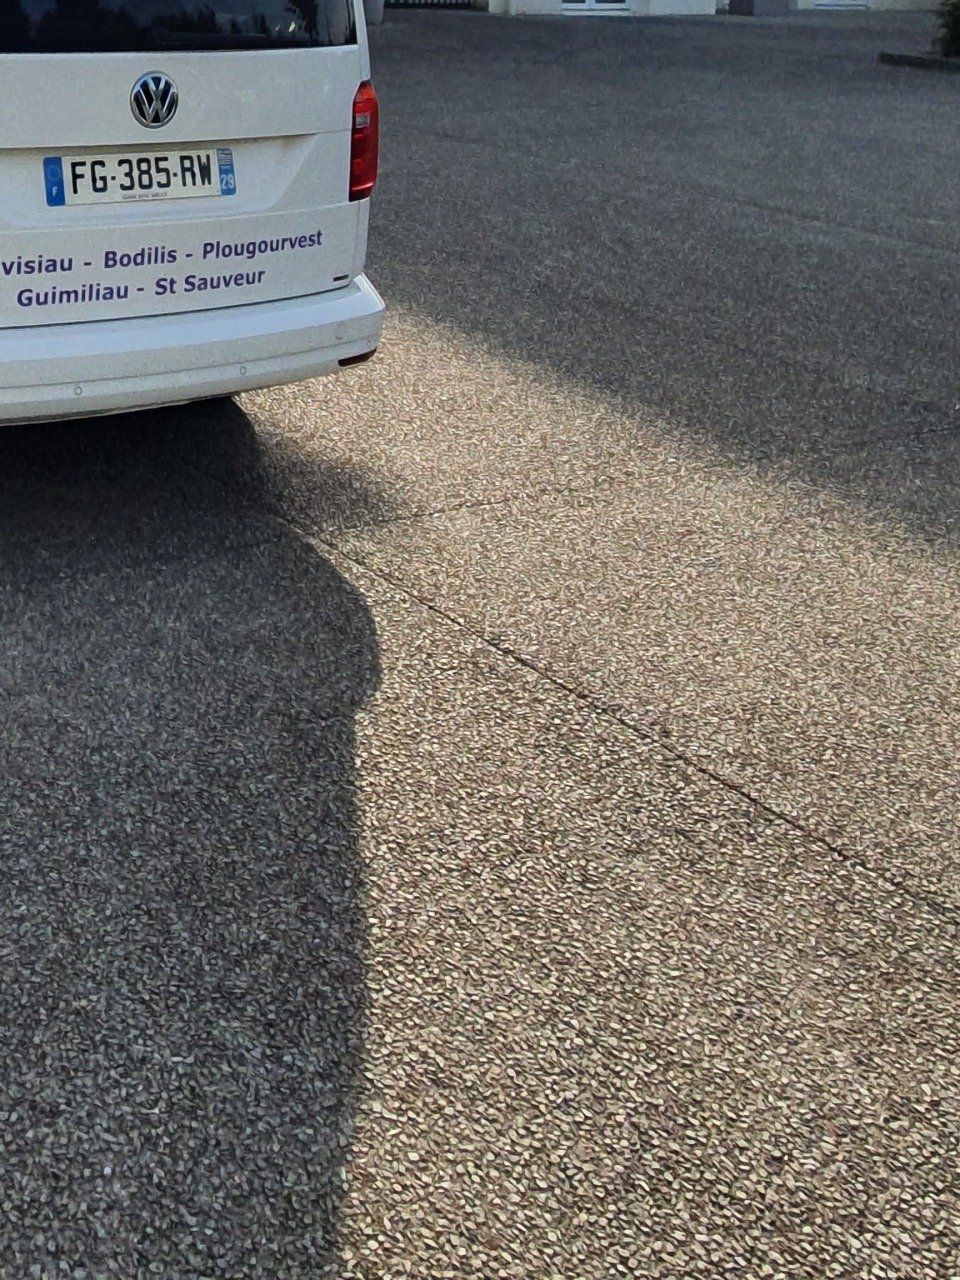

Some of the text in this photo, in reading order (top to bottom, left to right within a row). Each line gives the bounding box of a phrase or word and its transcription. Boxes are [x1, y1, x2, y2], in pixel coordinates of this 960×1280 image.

[70, 153, 212, 195] FG-385-RW
[220, 173, 235, 190] 29
[103, 246, 178, 269] Bodilis
[202, 229, 323, 260] Plougourvest
[17, 283, 129, 307] Guimiliau
[154, 277, 177, 296] St
[183, 270, 266, 293] Sauveur
